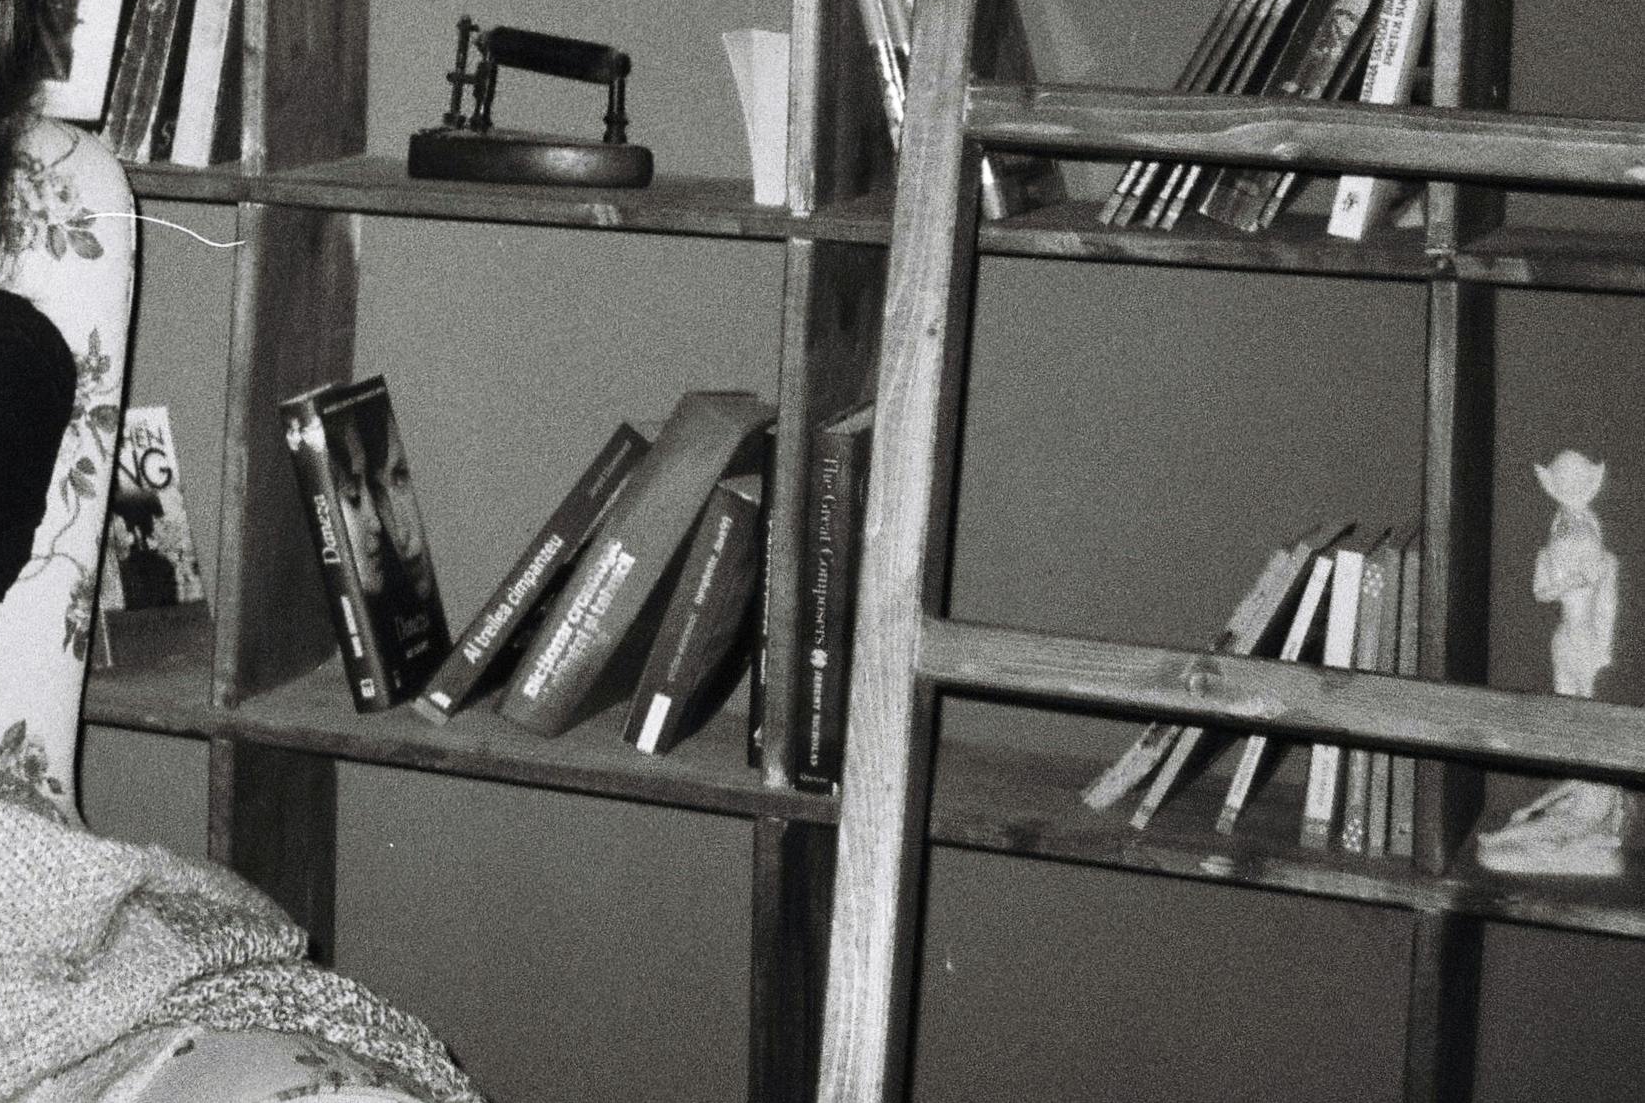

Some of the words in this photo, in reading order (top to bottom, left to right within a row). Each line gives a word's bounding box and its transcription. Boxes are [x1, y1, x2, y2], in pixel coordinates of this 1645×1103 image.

[819, 495, 836, 540] Great
[814, 548, 833, 643] Composers
[471, 599, 515, 649] treilea
[459, 640, 485, 665] Al
